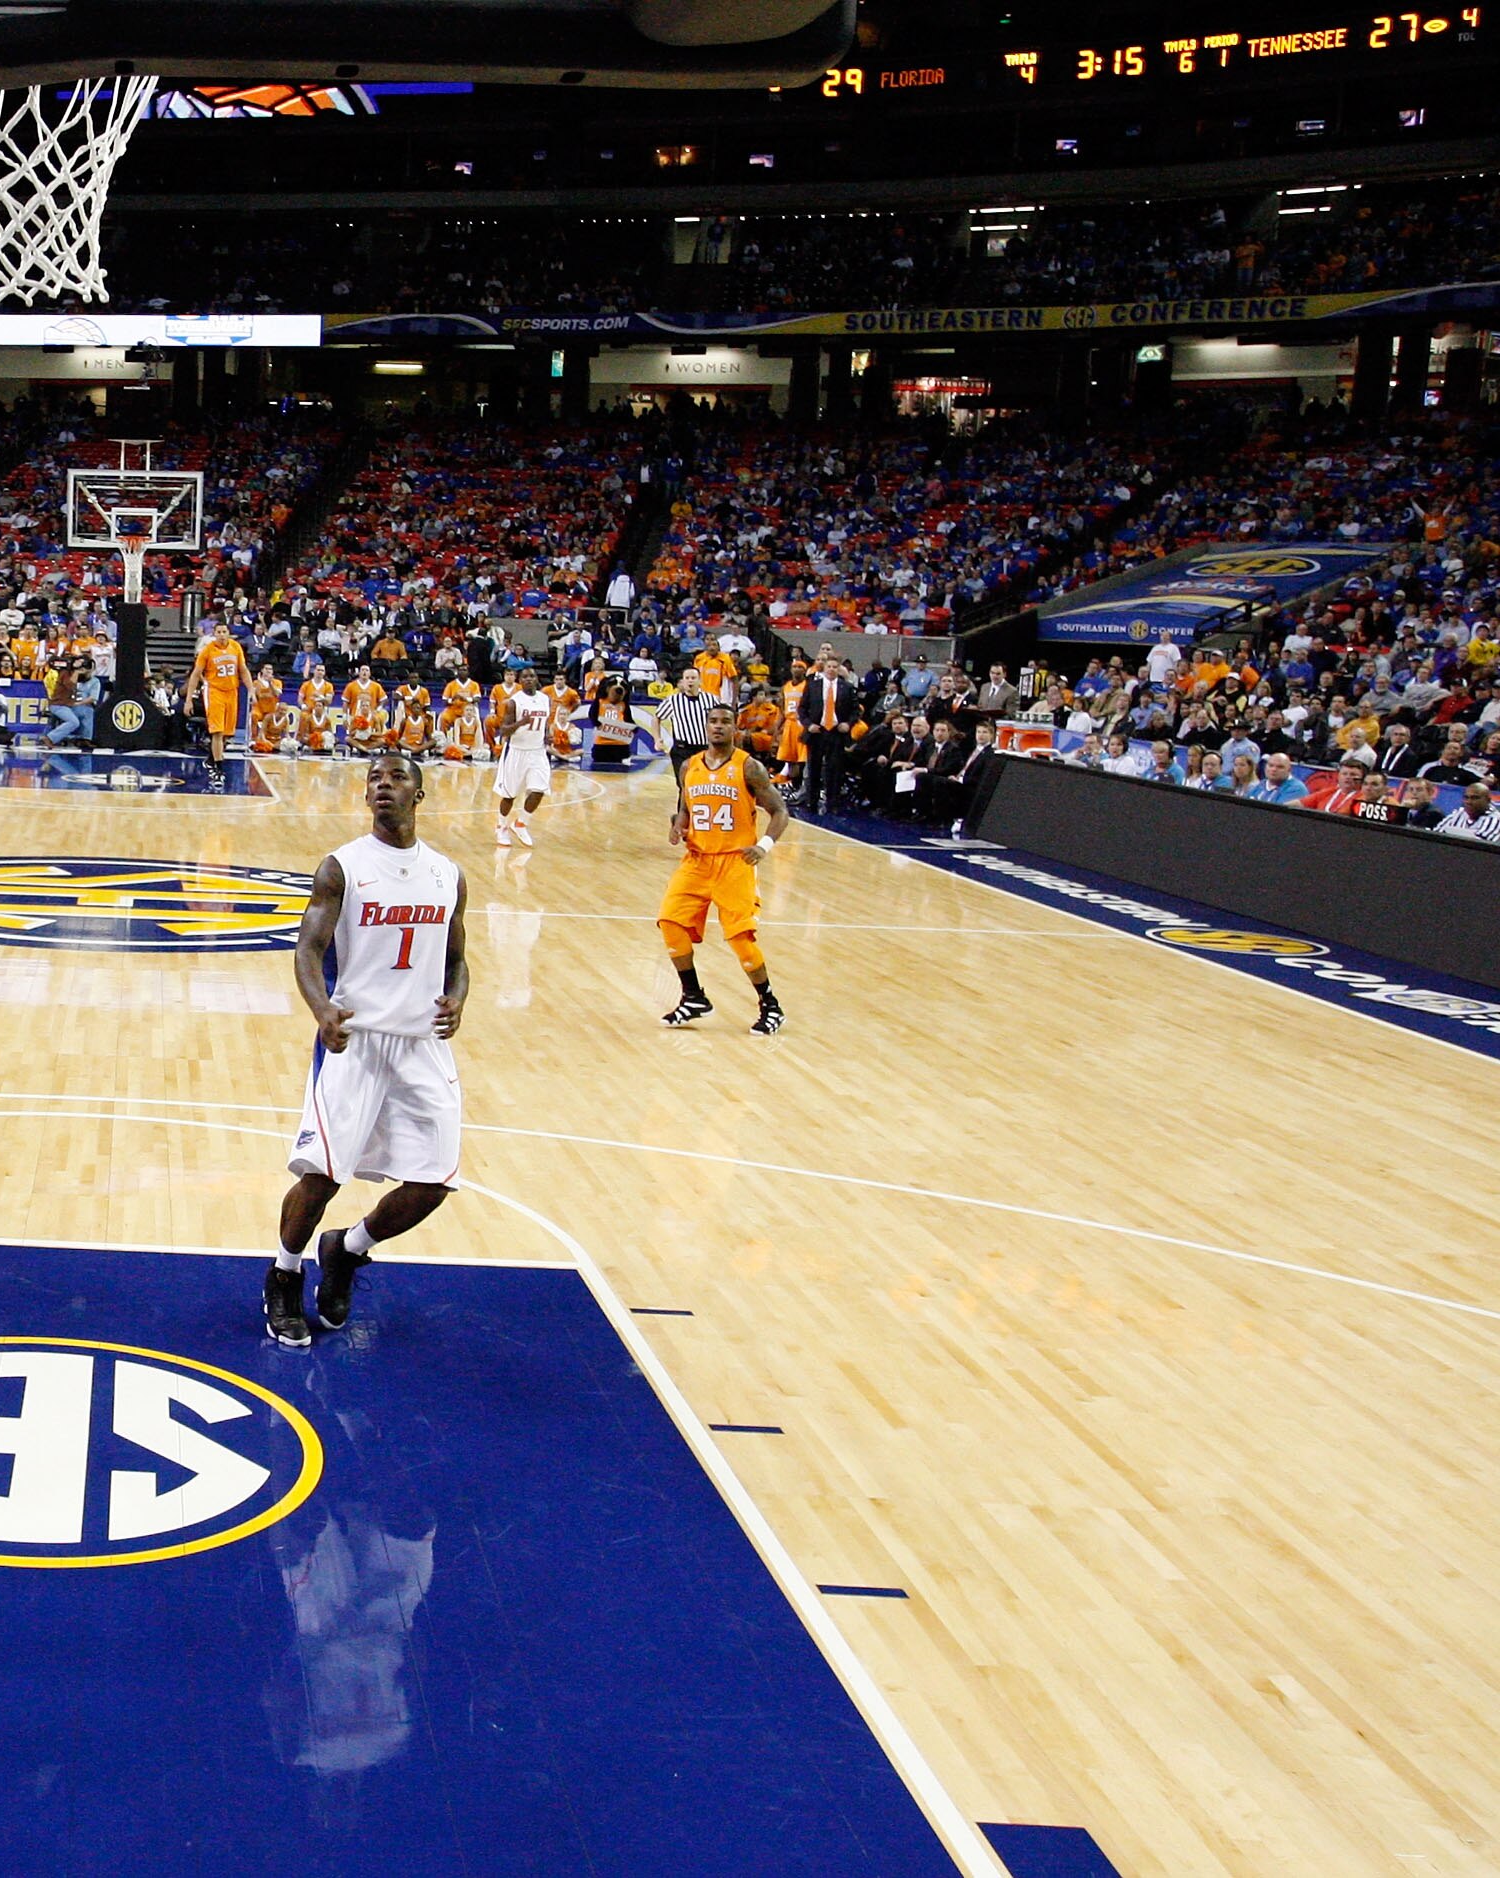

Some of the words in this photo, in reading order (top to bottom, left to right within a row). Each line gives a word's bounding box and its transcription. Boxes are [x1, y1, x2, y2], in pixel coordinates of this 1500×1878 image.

[1462, 8, 1478, 27] 4
[1369, 14, 1418, 48] 27
[1204, 34, 1239, 48] PERIOD
[1247, 29, 1347, 58] TENNESSEE
[1077, 47, 1143, 79] 3:15
[1179, 52, 1193, 73] 6
[1221, 49, 1227, 67] 1
[822, 69, 862, 97] 29
[880, 68, 944, 88] FLORIDA
[1021, 67, 1034, 84] 4
[502, 316, 629, 331] SECSPORTS.COM
[845, 308, 1043, 331] SOUTHEASTERN
[1110, 297, 1308, 323] CONFERENCE
[94, 359, 124, 369] MEN
[678, 362, 741, 373] WOMEN
[1196, 556, 1308, 575] SEC
[1056, 623, 1127, 634] SOUTHEASTERN
[216, 663, 237, 678] 33
[115, 702, 142, 730] SEC
[527, 716, 542, 731] 11
[688, 783, 739, 801] TENNESSEE
[692, 803, 734, 832] 24
[358, 901, 446, 927] FLORIDA
[390, 927, 415, 970] 1
